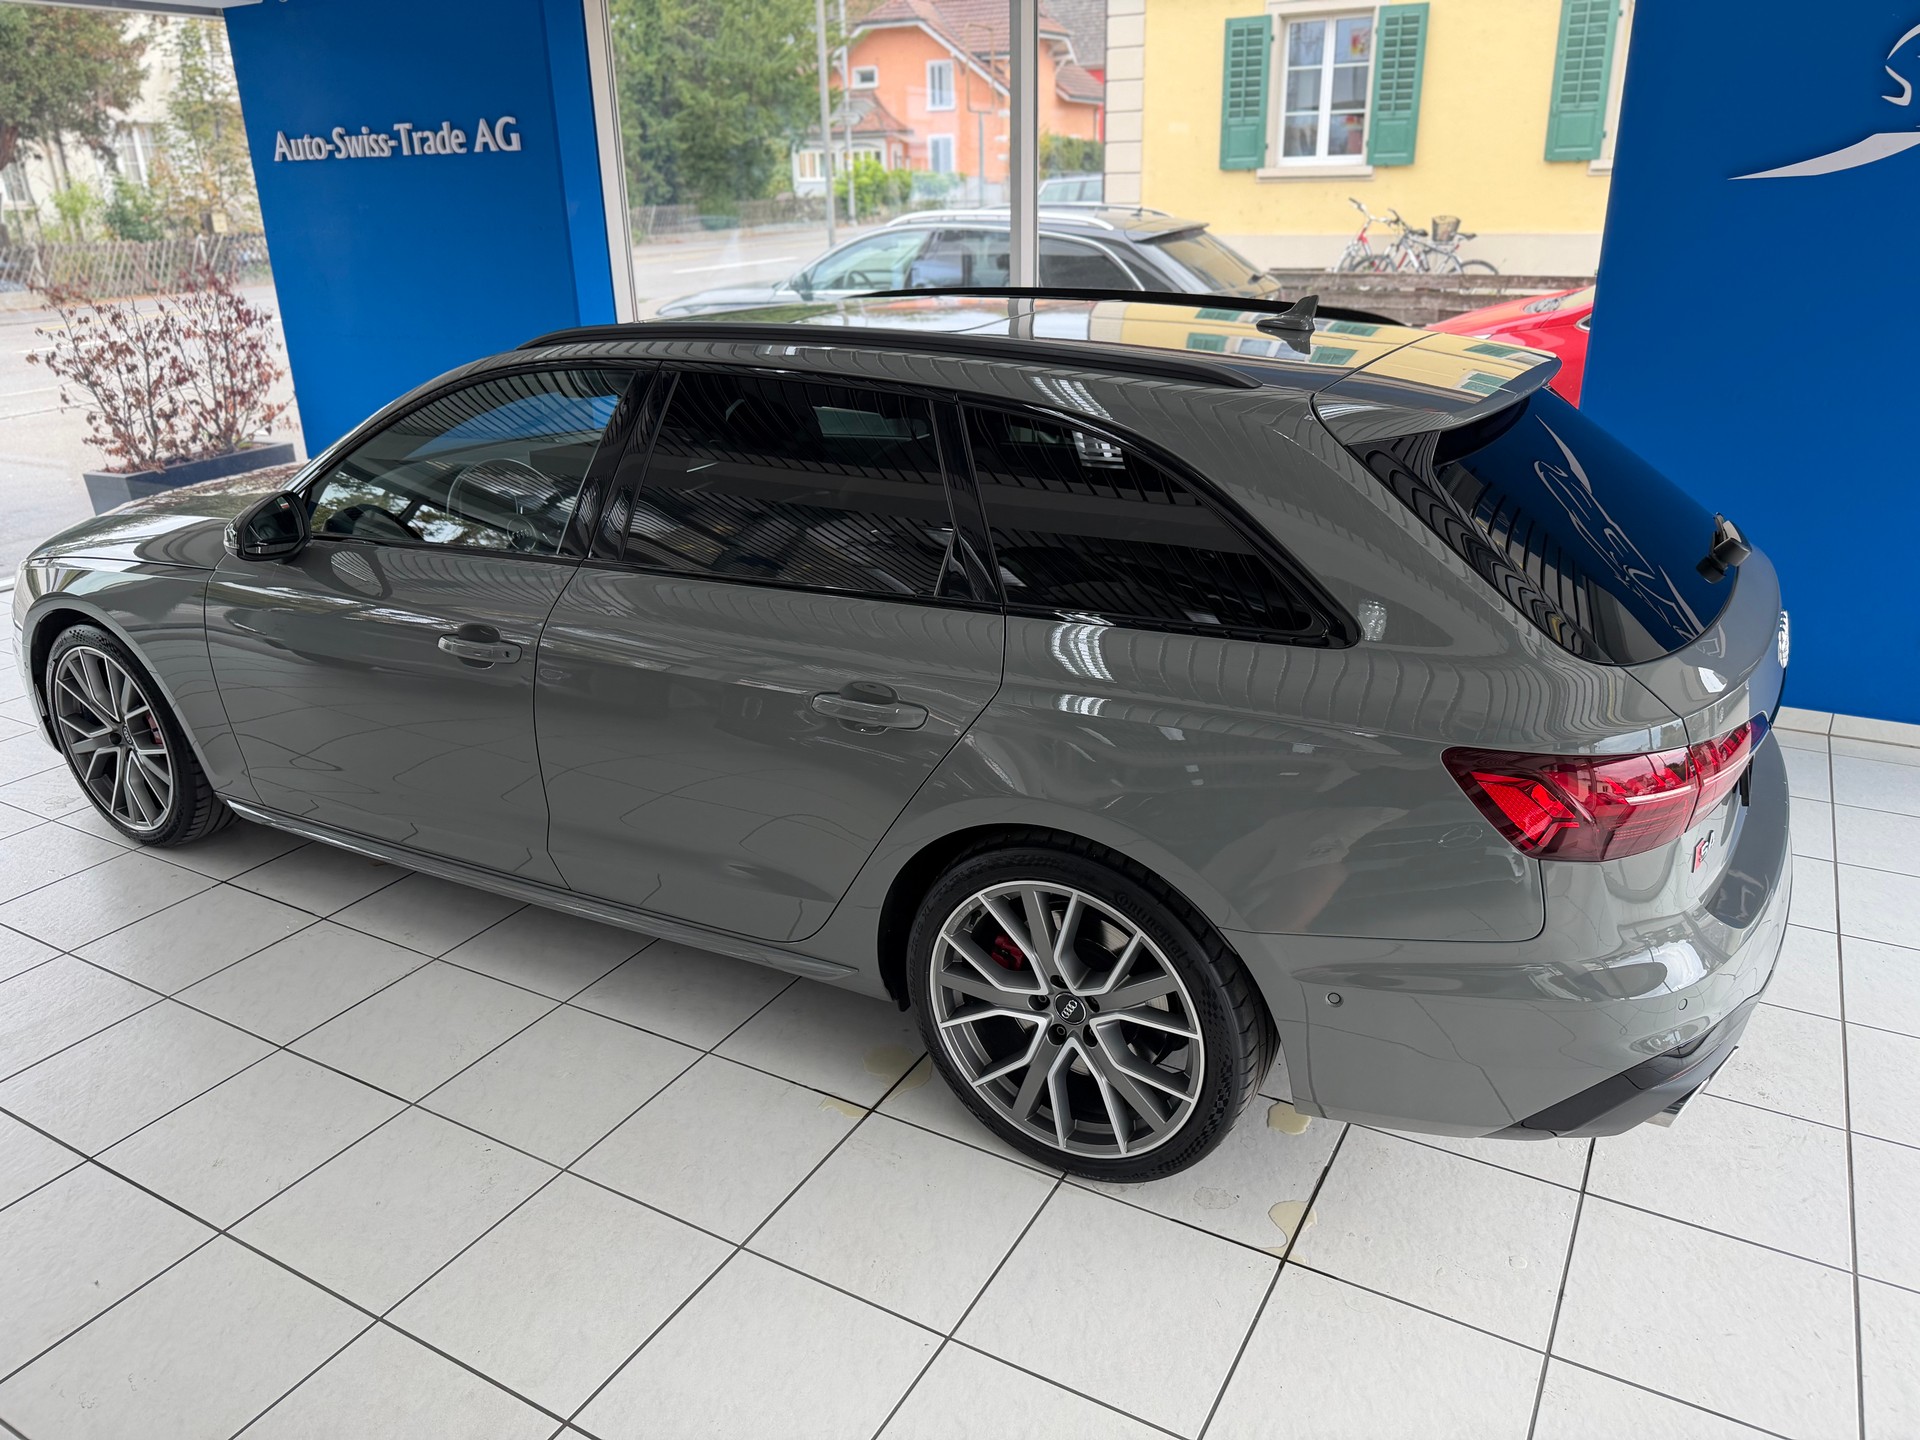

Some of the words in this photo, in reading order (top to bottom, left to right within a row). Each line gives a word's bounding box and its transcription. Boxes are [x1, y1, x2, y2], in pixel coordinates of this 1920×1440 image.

[274, 121, 467, 162] Auto-Swiss-Trade
[474, 116, 521, 152] AG
[1115, 892, 1189, 960] Continental
